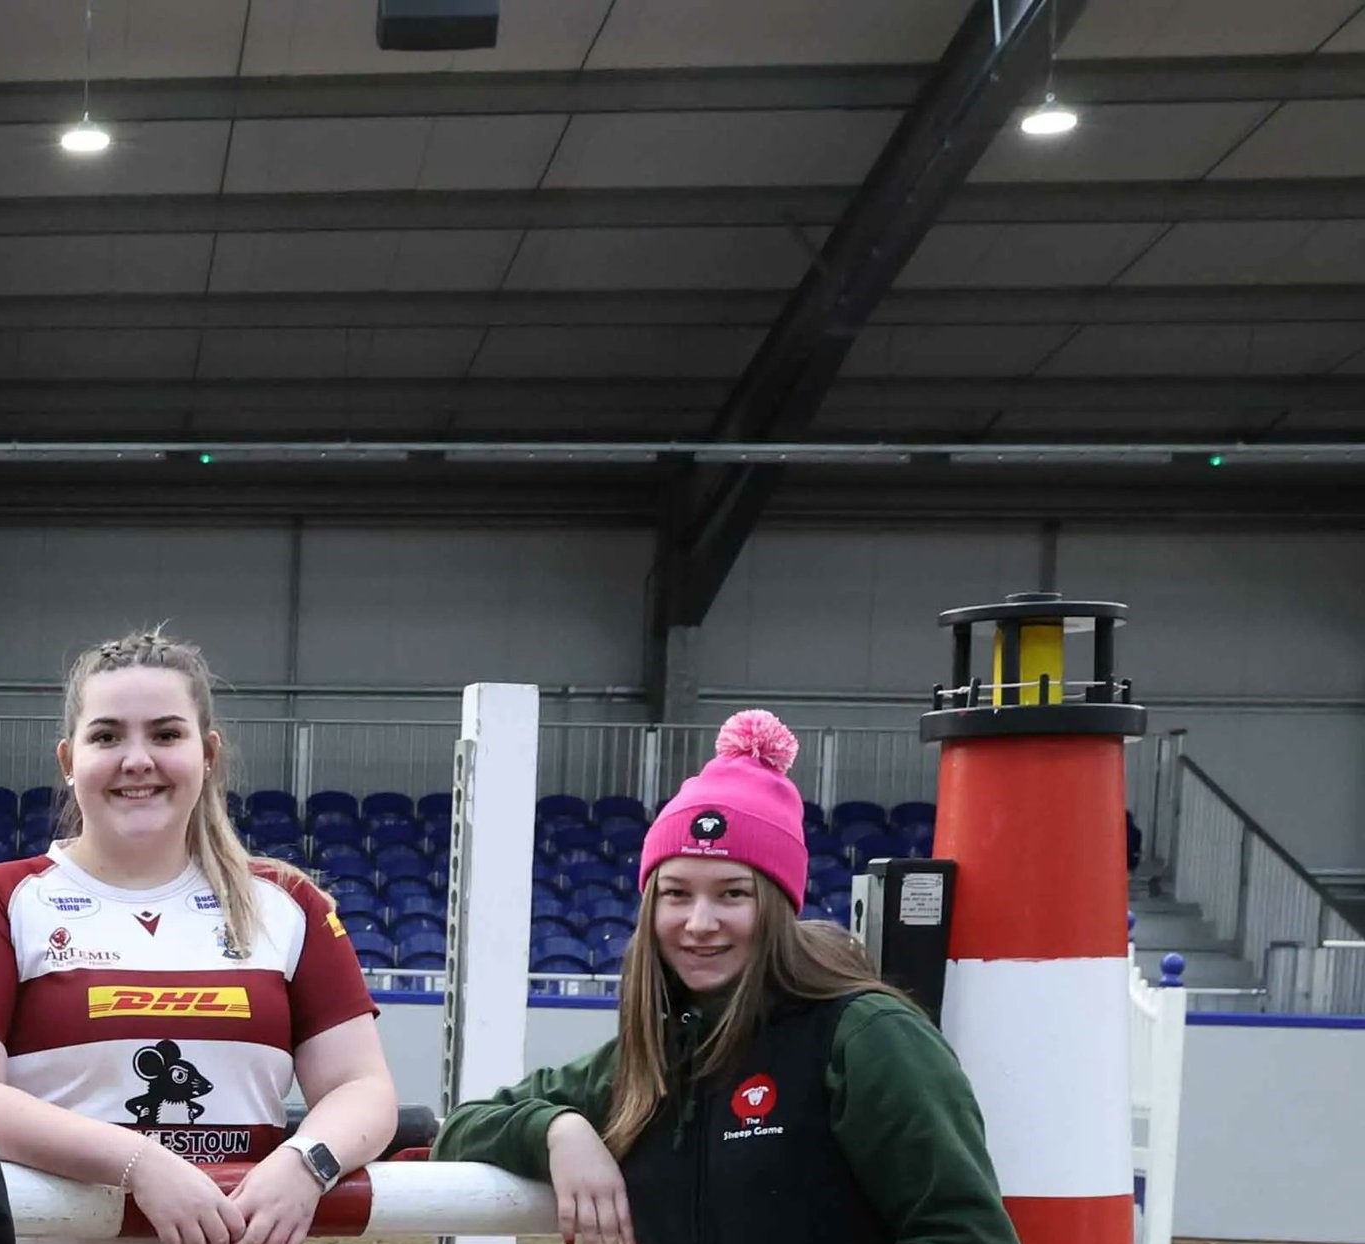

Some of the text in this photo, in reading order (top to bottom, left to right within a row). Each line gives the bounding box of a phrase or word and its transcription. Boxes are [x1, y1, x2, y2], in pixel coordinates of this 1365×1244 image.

[111, 990, 229, 1011] DHL
[723, 1126, 784, 1141] Sheep Game
